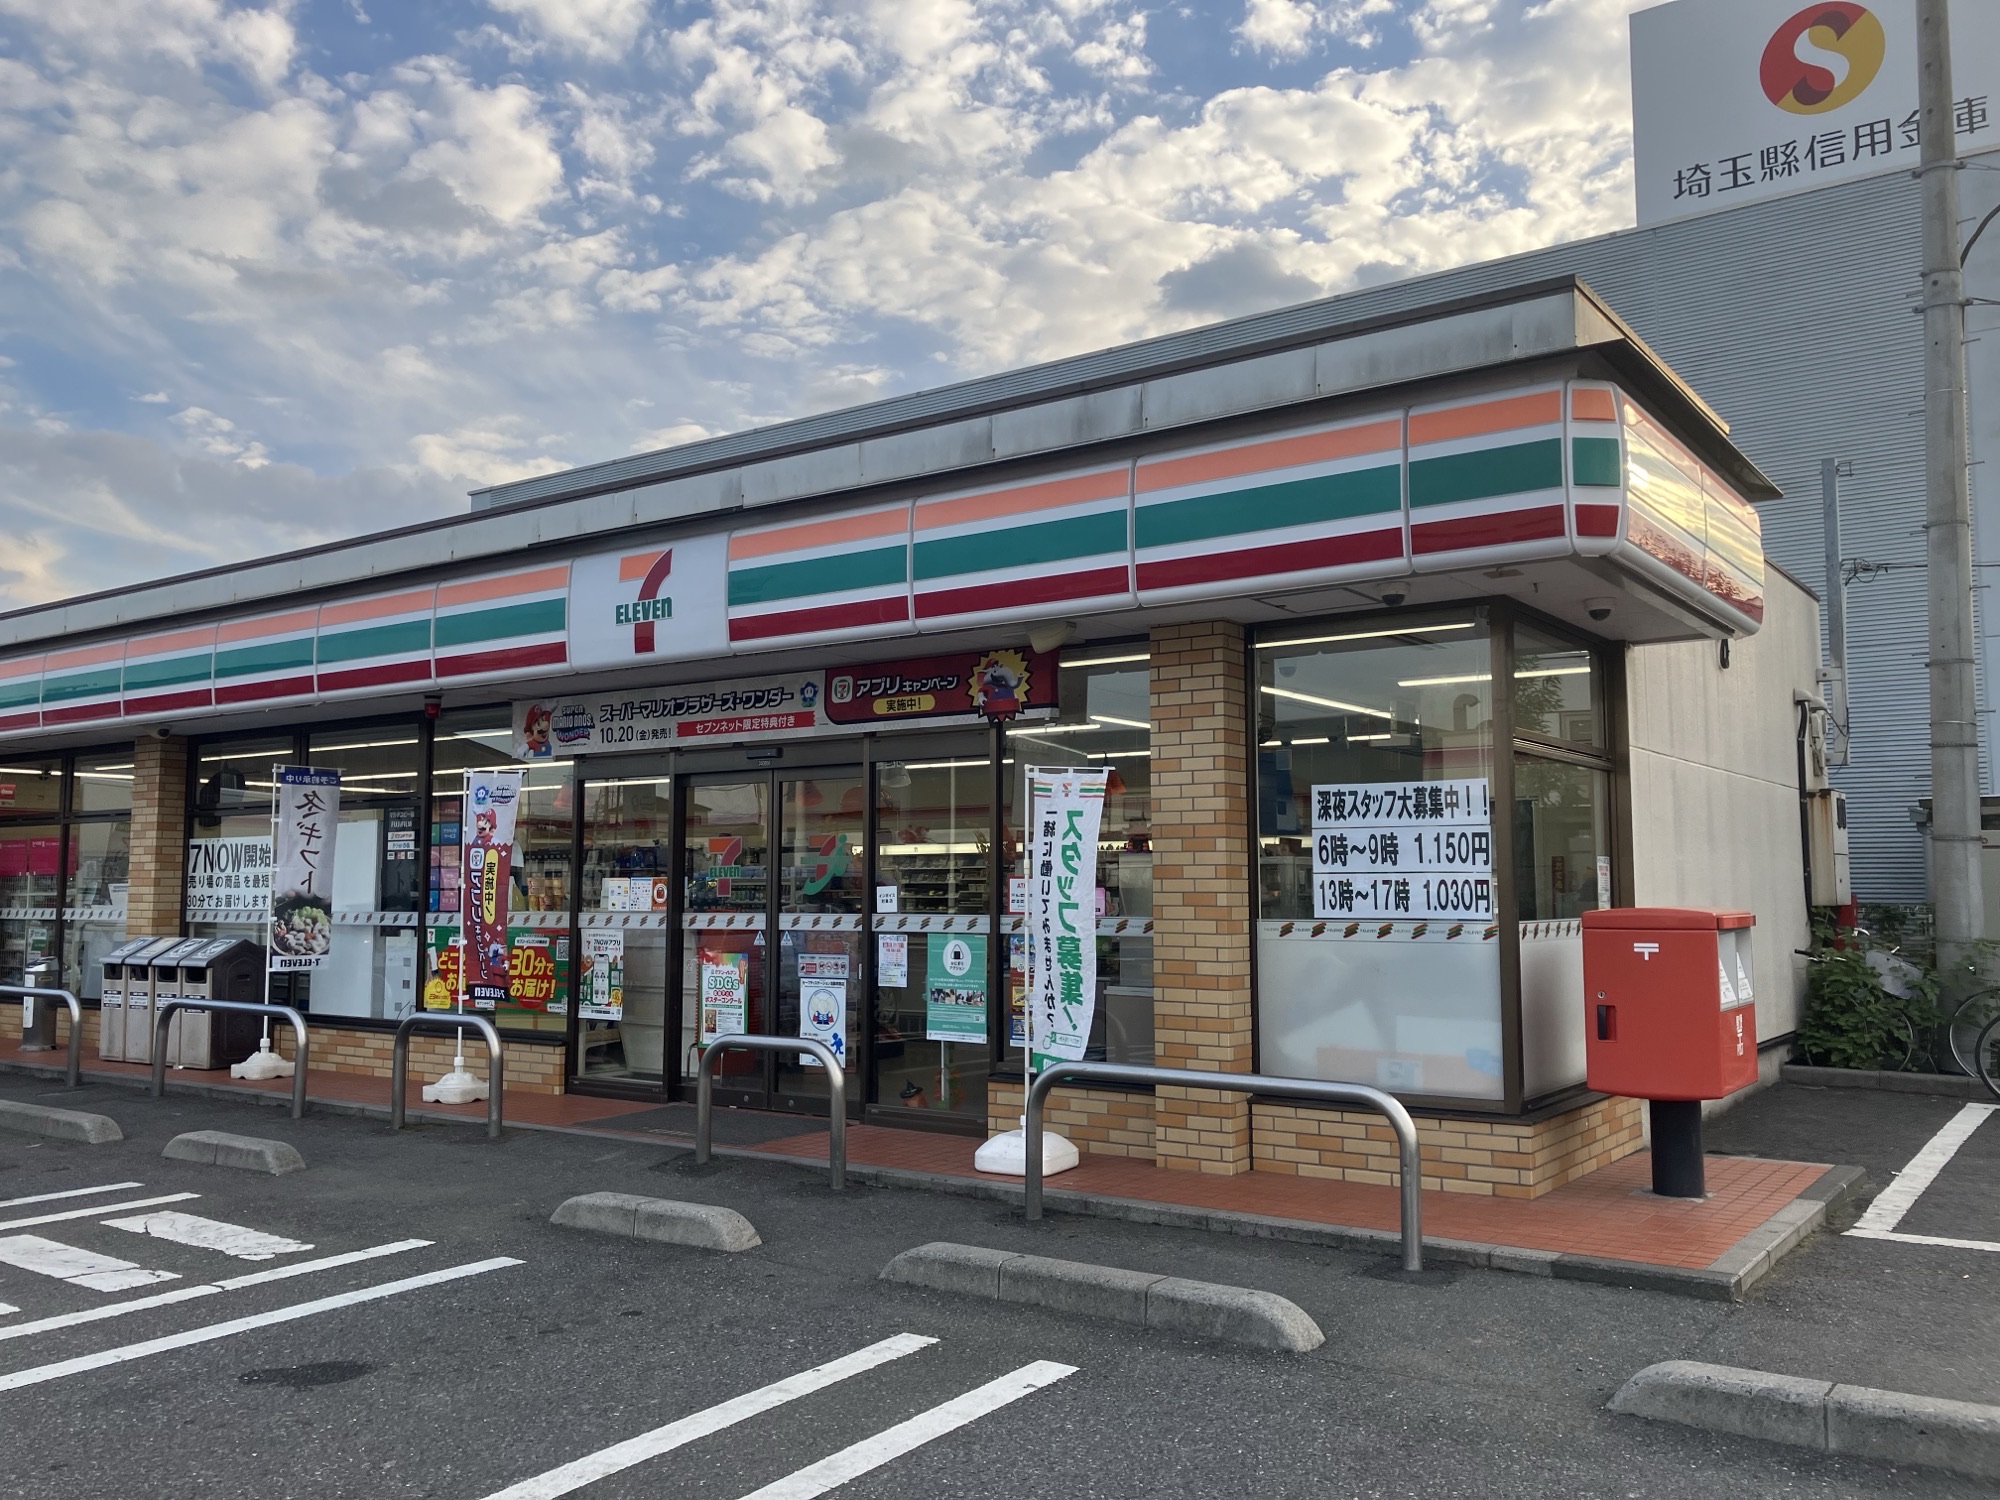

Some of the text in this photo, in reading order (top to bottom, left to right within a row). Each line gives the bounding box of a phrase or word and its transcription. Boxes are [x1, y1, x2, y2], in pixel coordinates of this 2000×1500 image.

[856, 676, 957, 698] アプリキャンペーン
[600, 687, 794, 722] スーパーマリオブラザーズ・ワンダー
[695, 715, 796, 733] セブンネット限定特典付き
[556, 727, 590, 741] WONDER
[390, 820, 413, 828] FUJIFILM
[508, 948, 555, 976] 30分で
[510, 978, 557, 999] お届け!
[708, 975, 740, 990] SDGs
